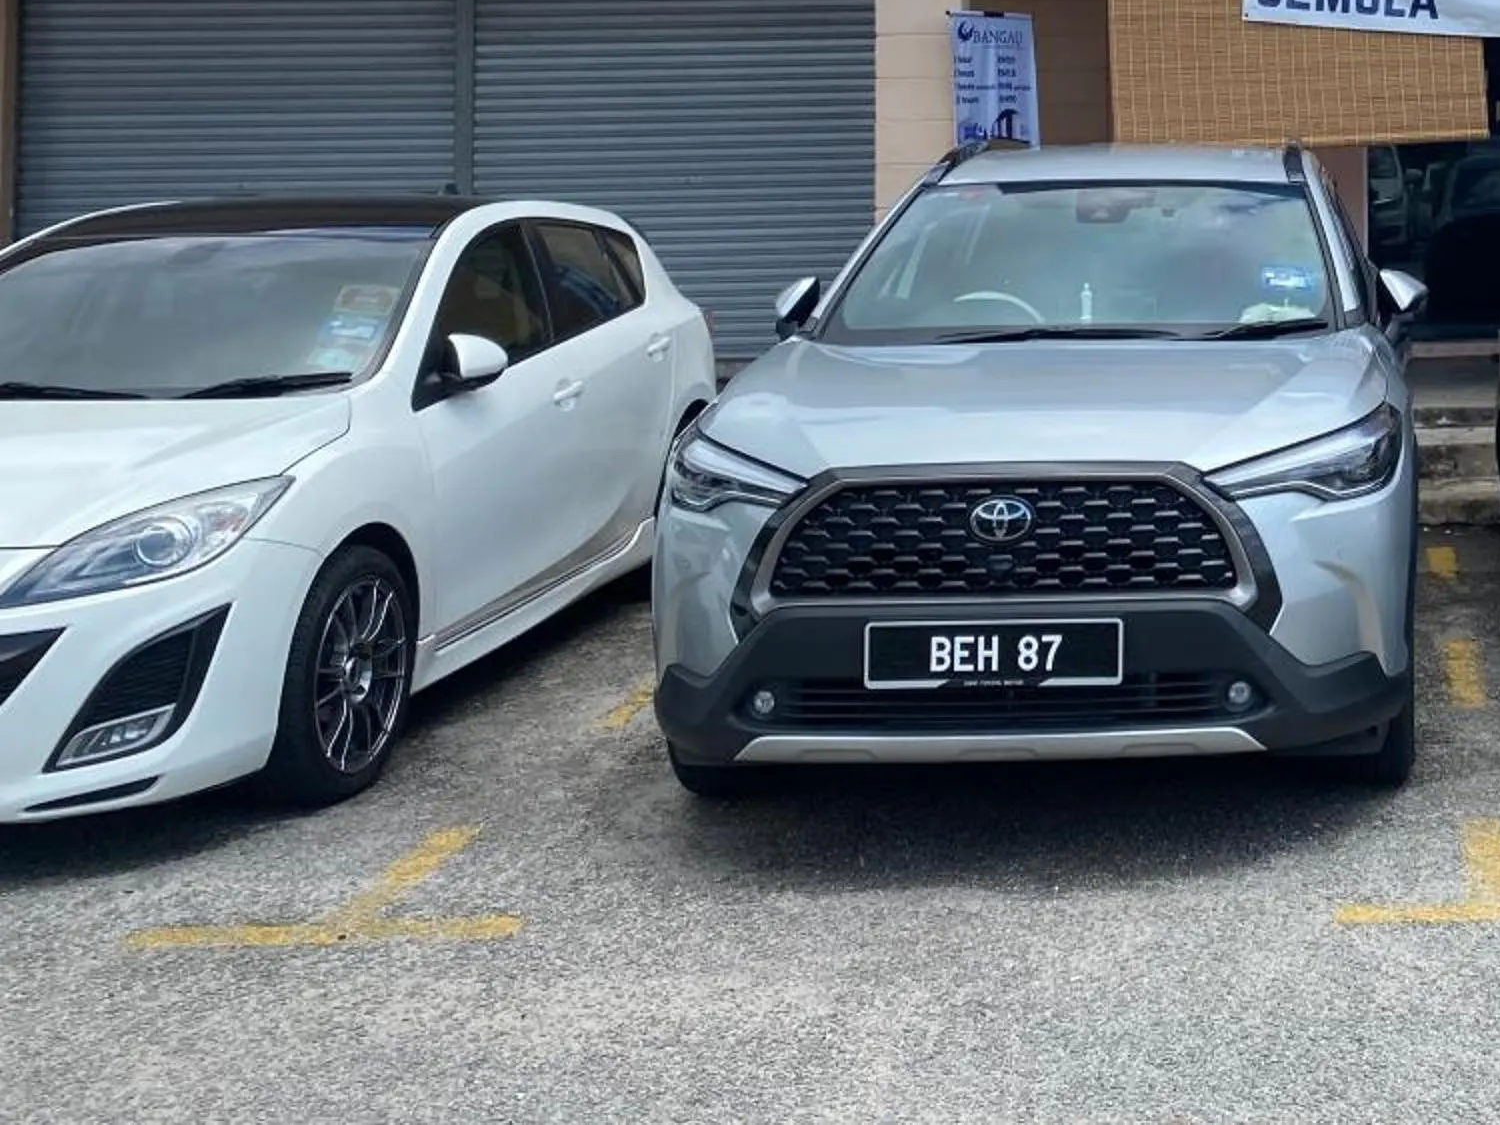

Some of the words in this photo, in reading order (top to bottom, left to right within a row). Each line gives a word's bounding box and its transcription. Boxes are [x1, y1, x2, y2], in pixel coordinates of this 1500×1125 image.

[973, 30, 1023, 45] BANGAU
[929, 635, 999, 672] BEH
[1017, 634, 1063, 672] 87
